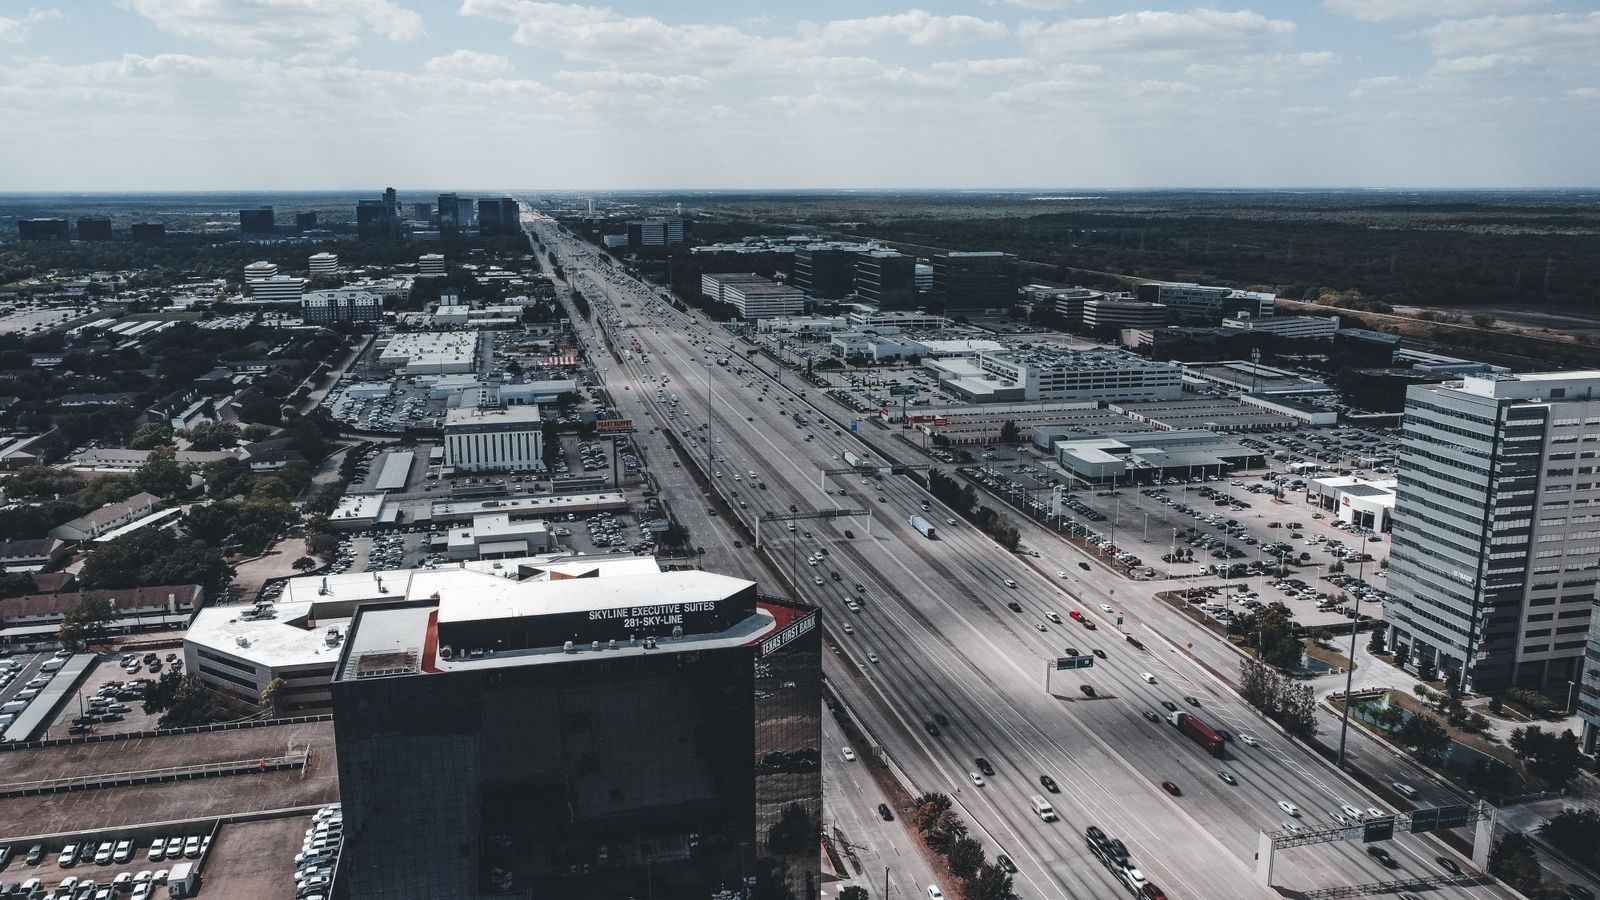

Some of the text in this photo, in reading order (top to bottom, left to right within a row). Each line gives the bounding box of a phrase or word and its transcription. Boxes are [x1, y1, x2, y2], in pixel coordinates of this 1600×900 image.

[589, 601, 714, 620] SKYLINE EXECUTIVE SUITES
[624, 615, 683, 627] 281-SKY-LINE
[762, 615, 816, 655] TEXAS FIRST BANK
